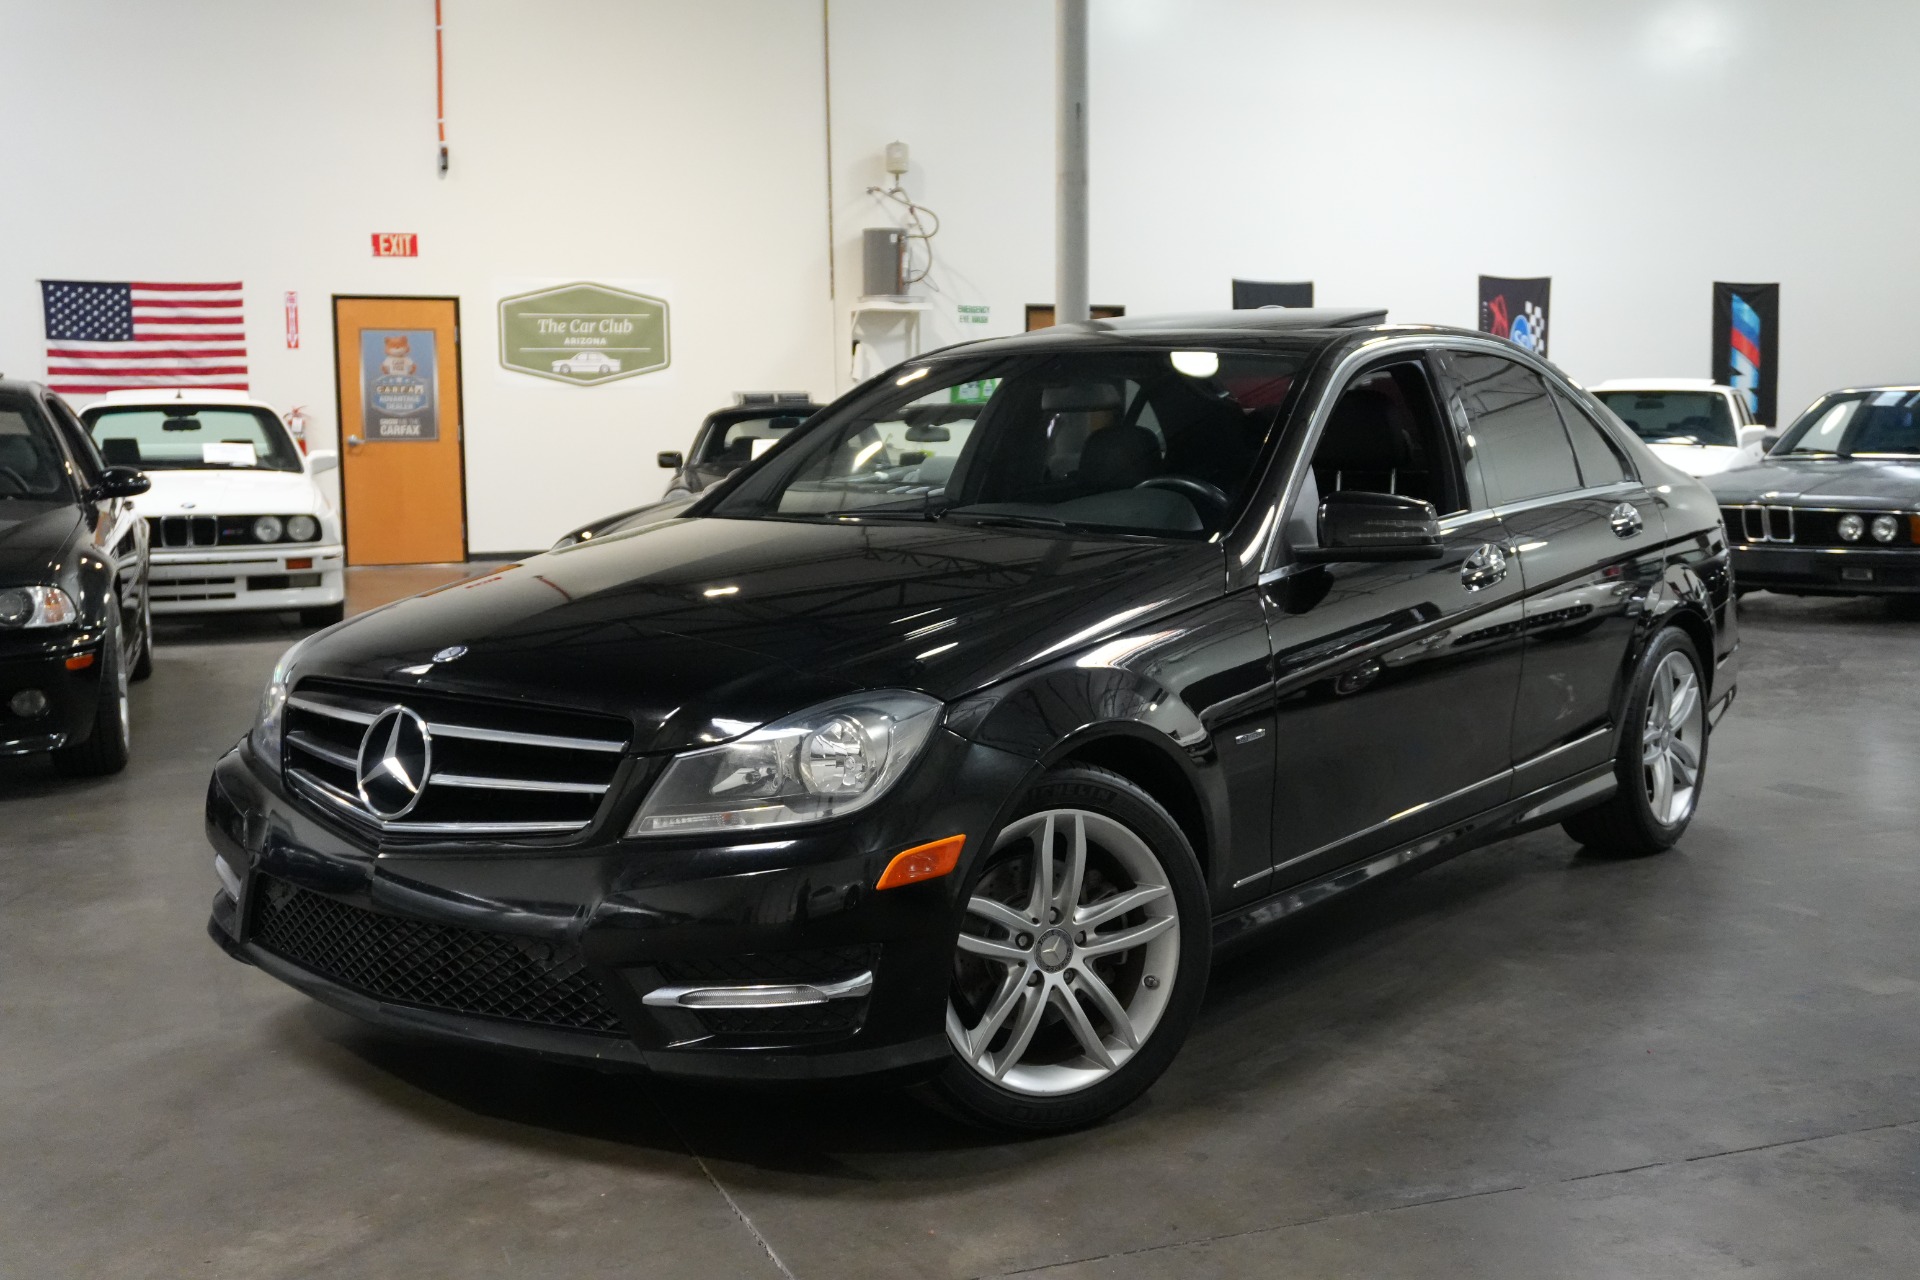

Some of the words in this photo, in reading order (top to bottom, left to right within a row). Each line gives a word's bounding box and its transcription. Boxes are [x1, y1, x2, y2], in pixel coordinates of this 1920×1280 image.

[380, 233, 411, 256] EXIT
[538, 319, 566, 333] The
[570, 319, 596, 333] Car
[599, 319, 633, 333] Club
[564, 337, 607, 345] ARIZONA
[380, 425, 421, 436] CARFAX
